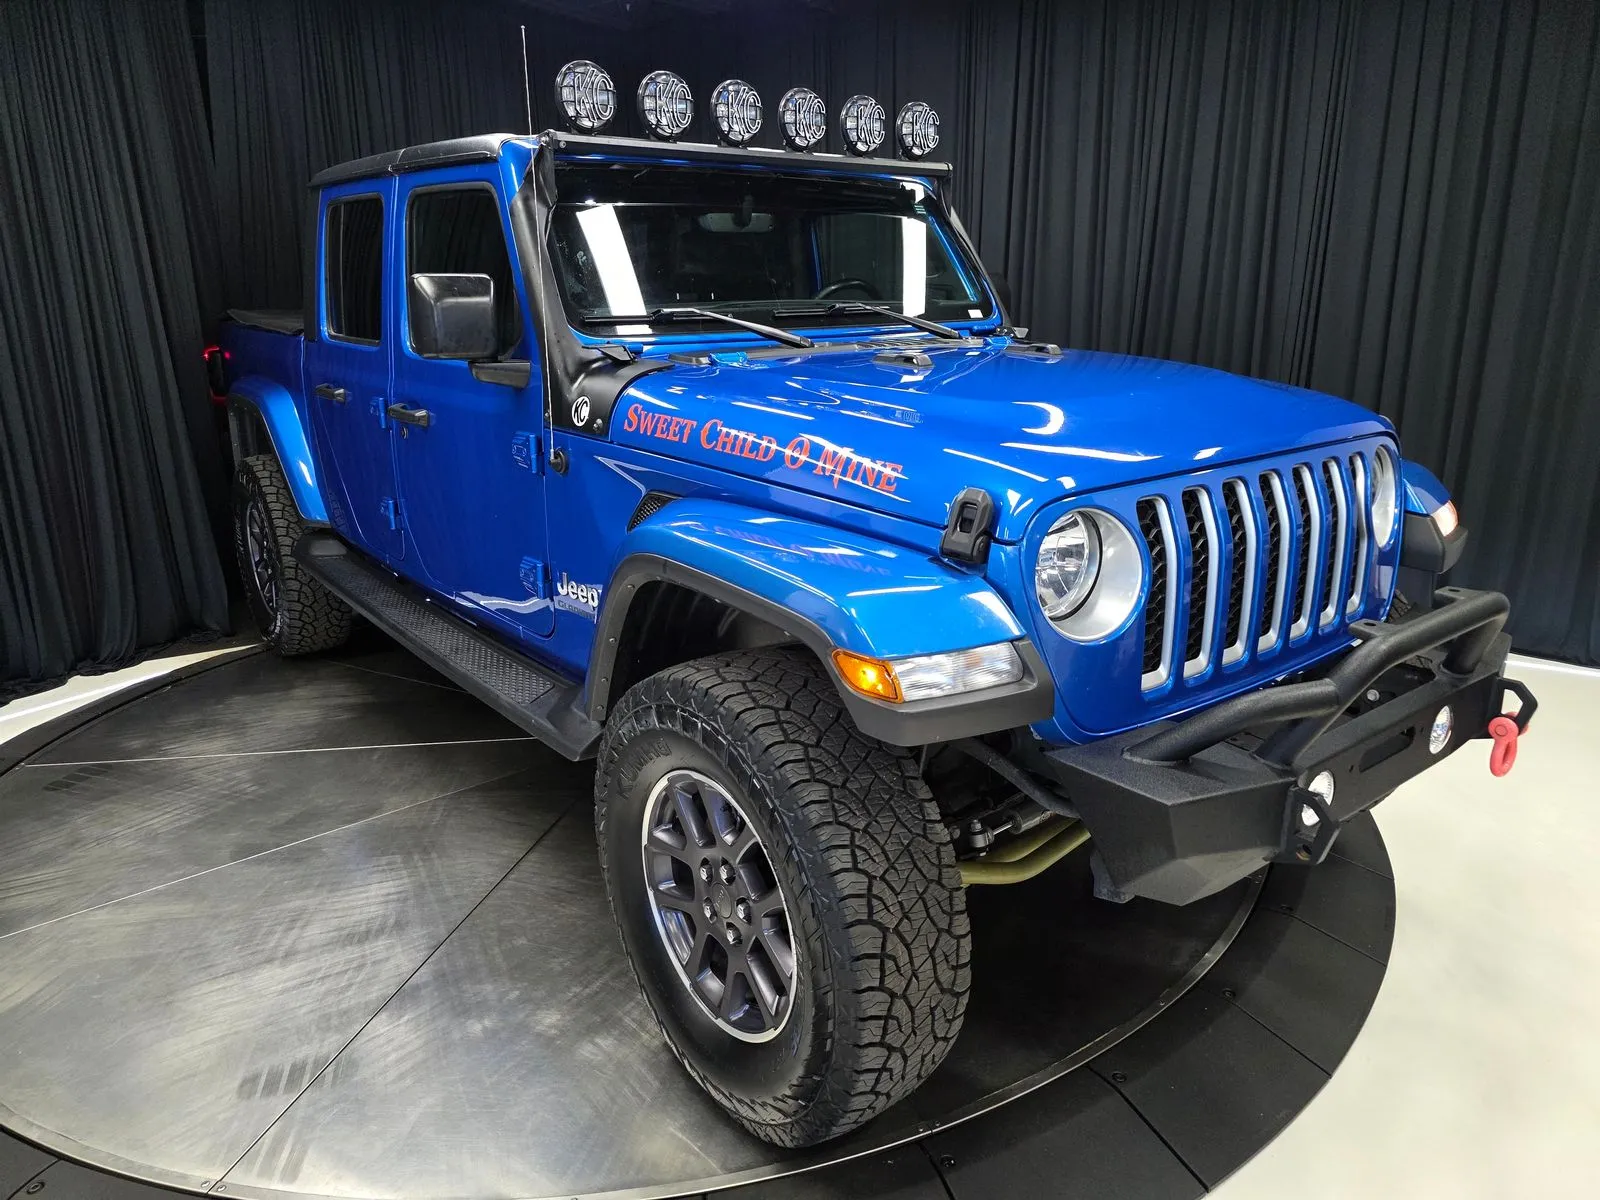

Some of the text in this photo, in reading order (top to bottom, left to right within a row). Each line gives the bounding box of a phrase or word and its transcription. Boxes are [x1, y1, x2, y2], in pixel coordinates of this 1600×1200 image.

[574, 66, 614, 122] KC
[656, 78, 692, 130] KC
[728, 86, 762, 135] KC
[796, 93, 826, 141] KC
[857, 101, 886, 146] KC
[913, 107, 940, 150] KC
[573, 398, 589, 425] KC
[623, 403, 904, 492] SWEET CHILD O MINE
[557, 571, 599, 608] Jeep
